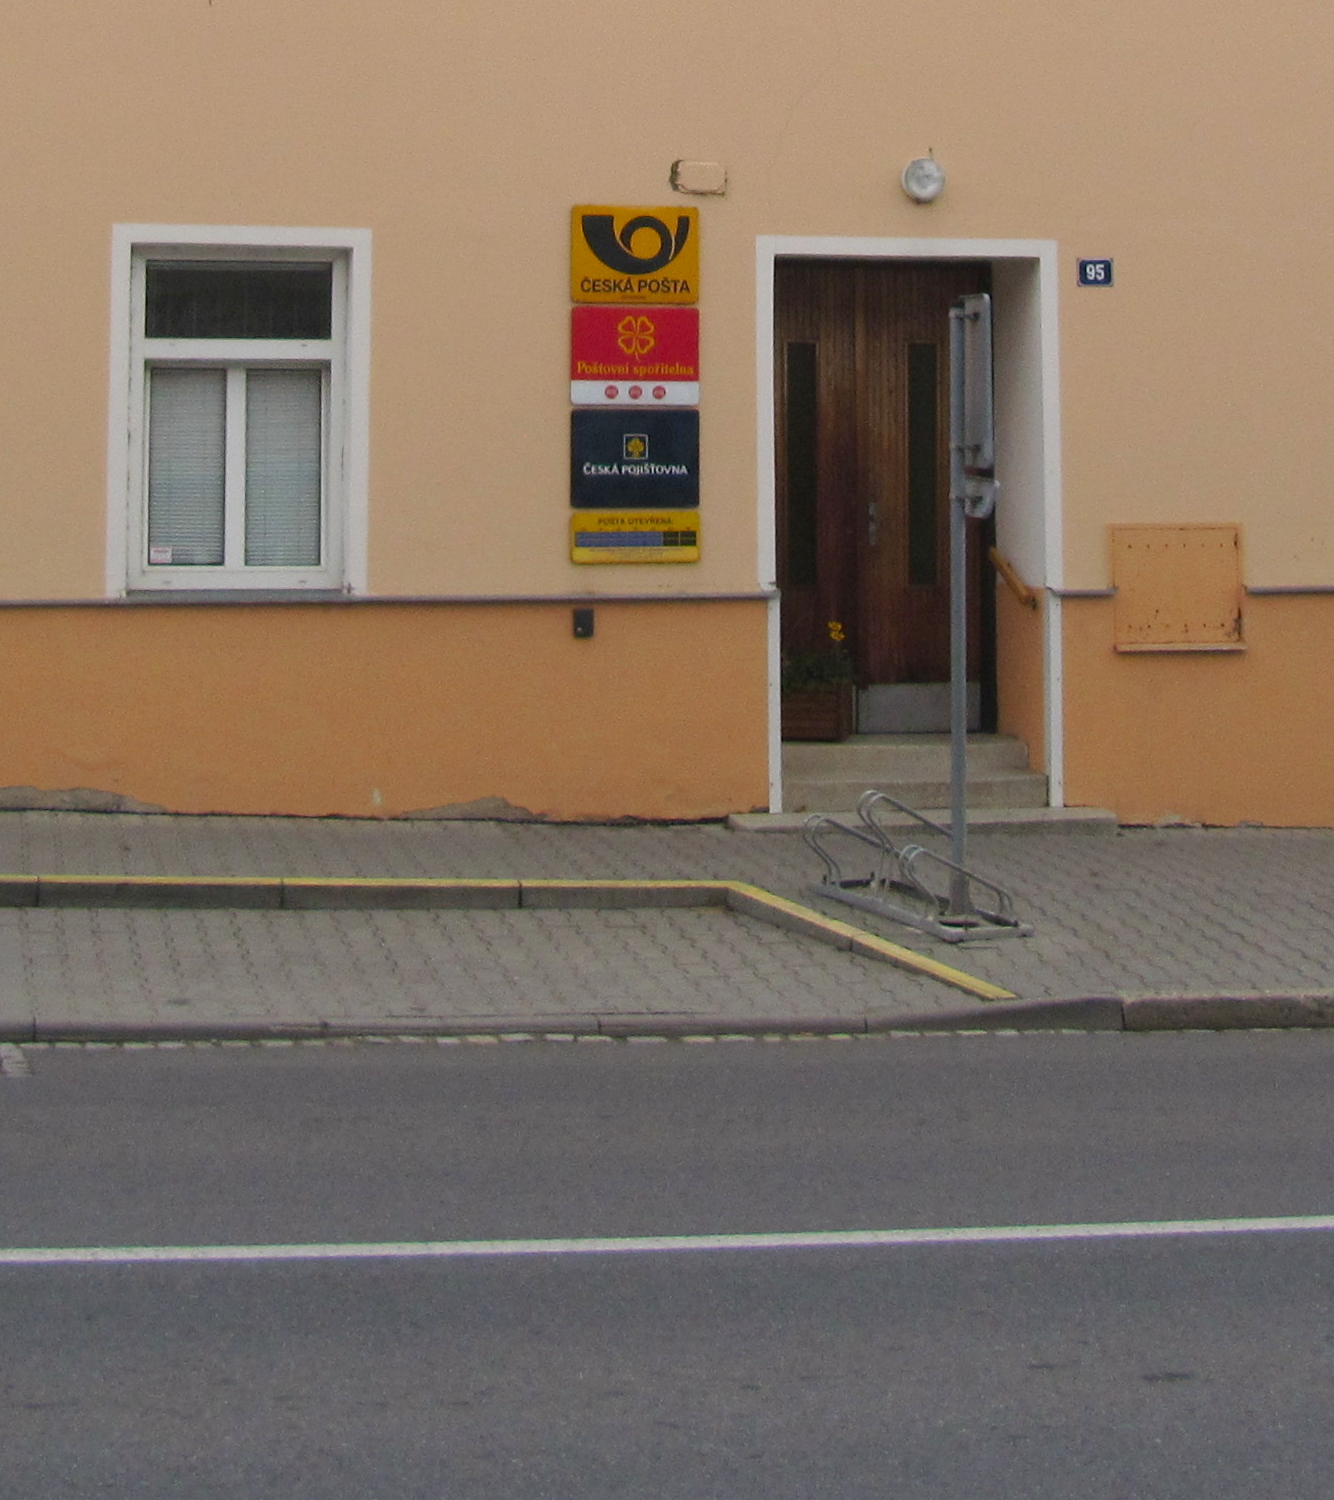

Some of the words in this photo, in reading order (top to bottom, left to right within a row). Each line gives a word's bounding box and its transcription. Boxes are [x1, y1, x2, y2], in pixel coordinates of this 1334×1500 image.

[1086, 263, 1105, 280] 95
[581, 277, 634, 292] ČESKÁ
[638, 277, 690, 293] POŠTA
[578, 362, 629, 374] Poštovní
[635, 363, 693, 376] spořitelna
[583, 462, 619, 475] ČESKÁ
